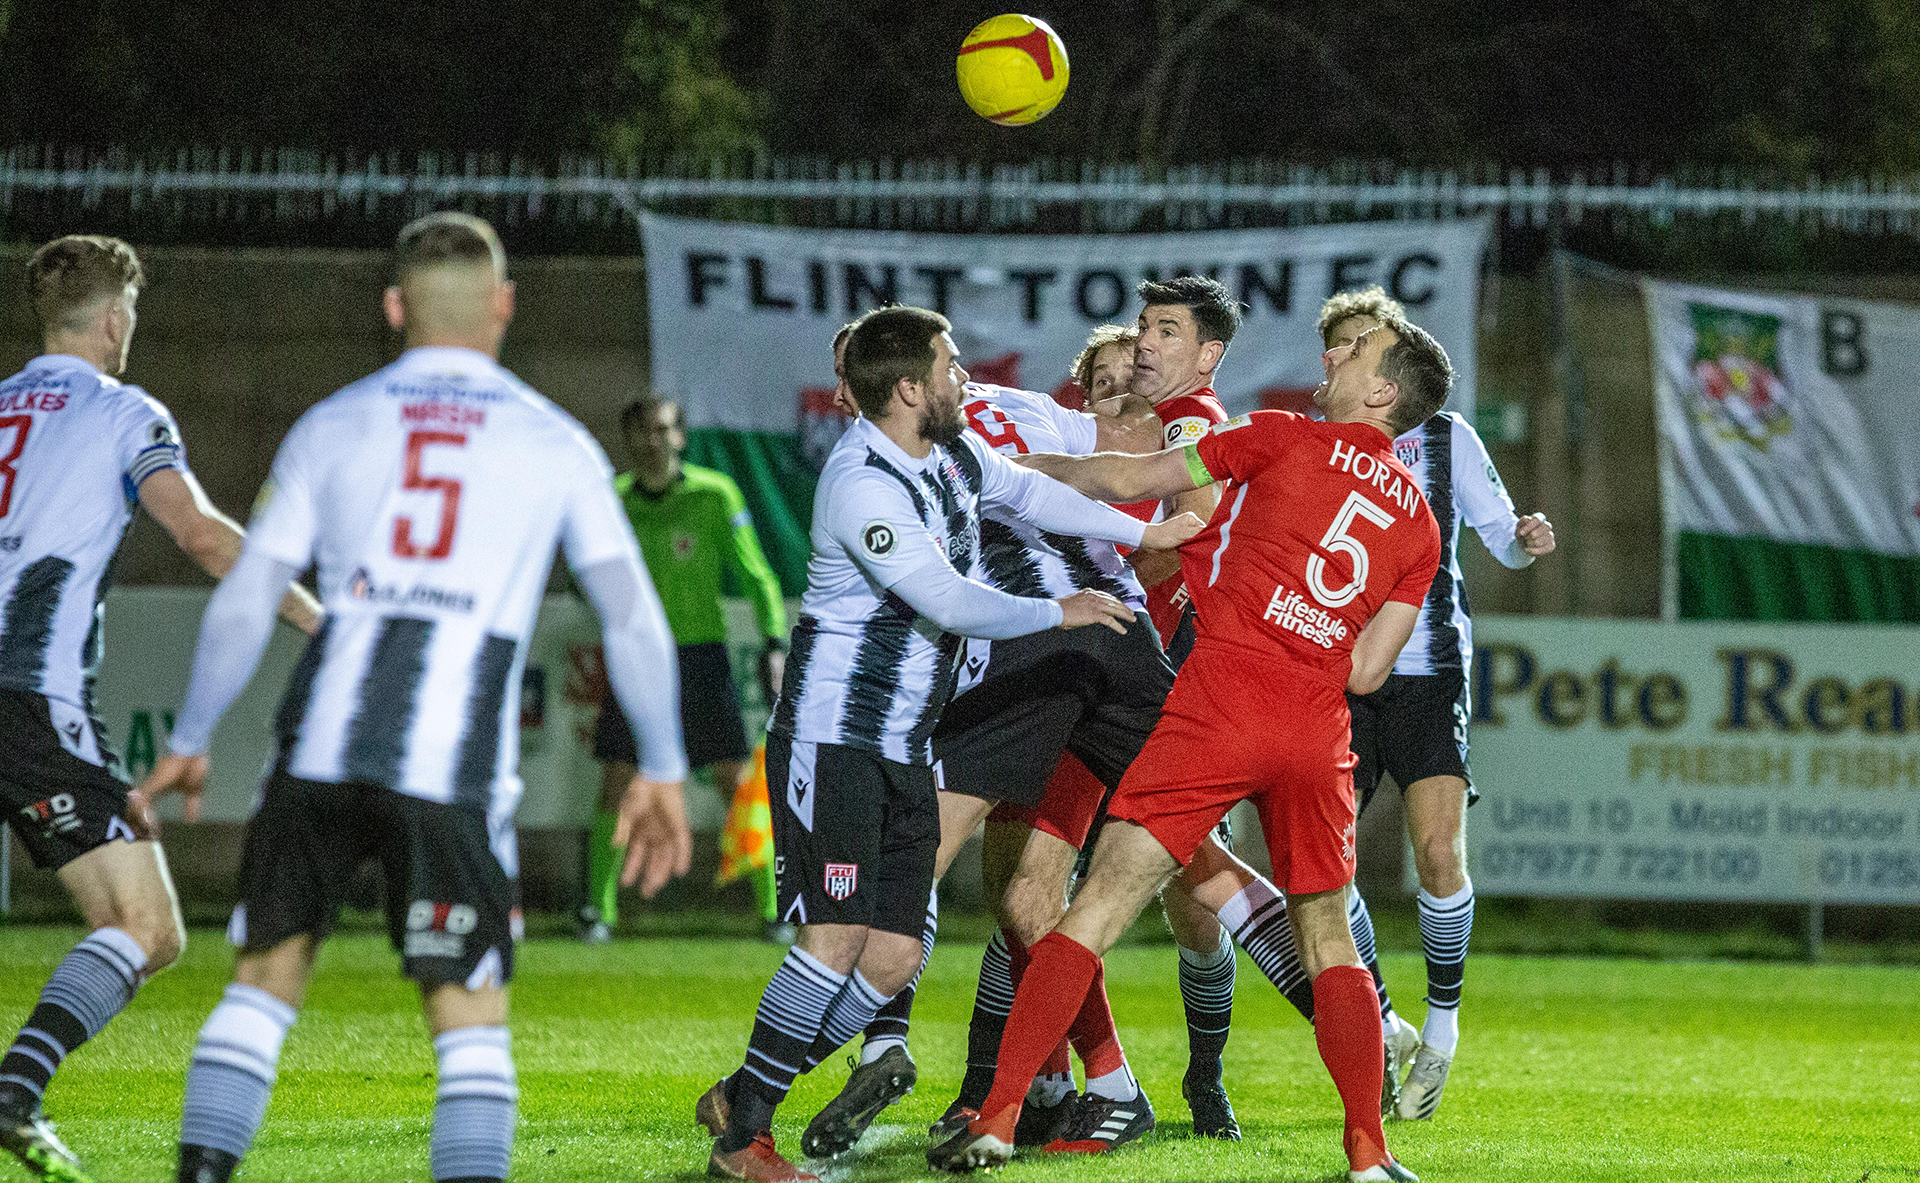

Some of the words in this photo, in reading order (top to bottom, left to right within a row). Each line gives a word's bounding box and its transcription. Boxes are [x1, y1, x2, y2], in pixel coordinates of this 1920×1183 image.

[686, 252, 964, 316] FLINT
[1329, 251, 1441, 305] FC
[1822, 308, 1869, 379] B
[393, 430, 468, 562] 5
[1328, 439, 1421, 518] HORAN
[870, 528, 891, 551] JD
[1305, 490, 1397, 608] 5
[1263, 604, 1334, 650] Fitness
[1271, 584, 1348, 641] Lifestyle
[1472, 641, 1690, 733] Pete
[1712, 645, 1920, 738] Rea
[1627, 744, 1793, 787] FRESH
[1806, 747, 1919, 791] FISH
[1491, 797, 1571, 832] Unit
[1587, 799, 1634, 834] 10
[1669, 801, 1768, 838] Mold
[1778, 802, 1905, 841] Indoor
[829, 867, 853, 877] FTU
